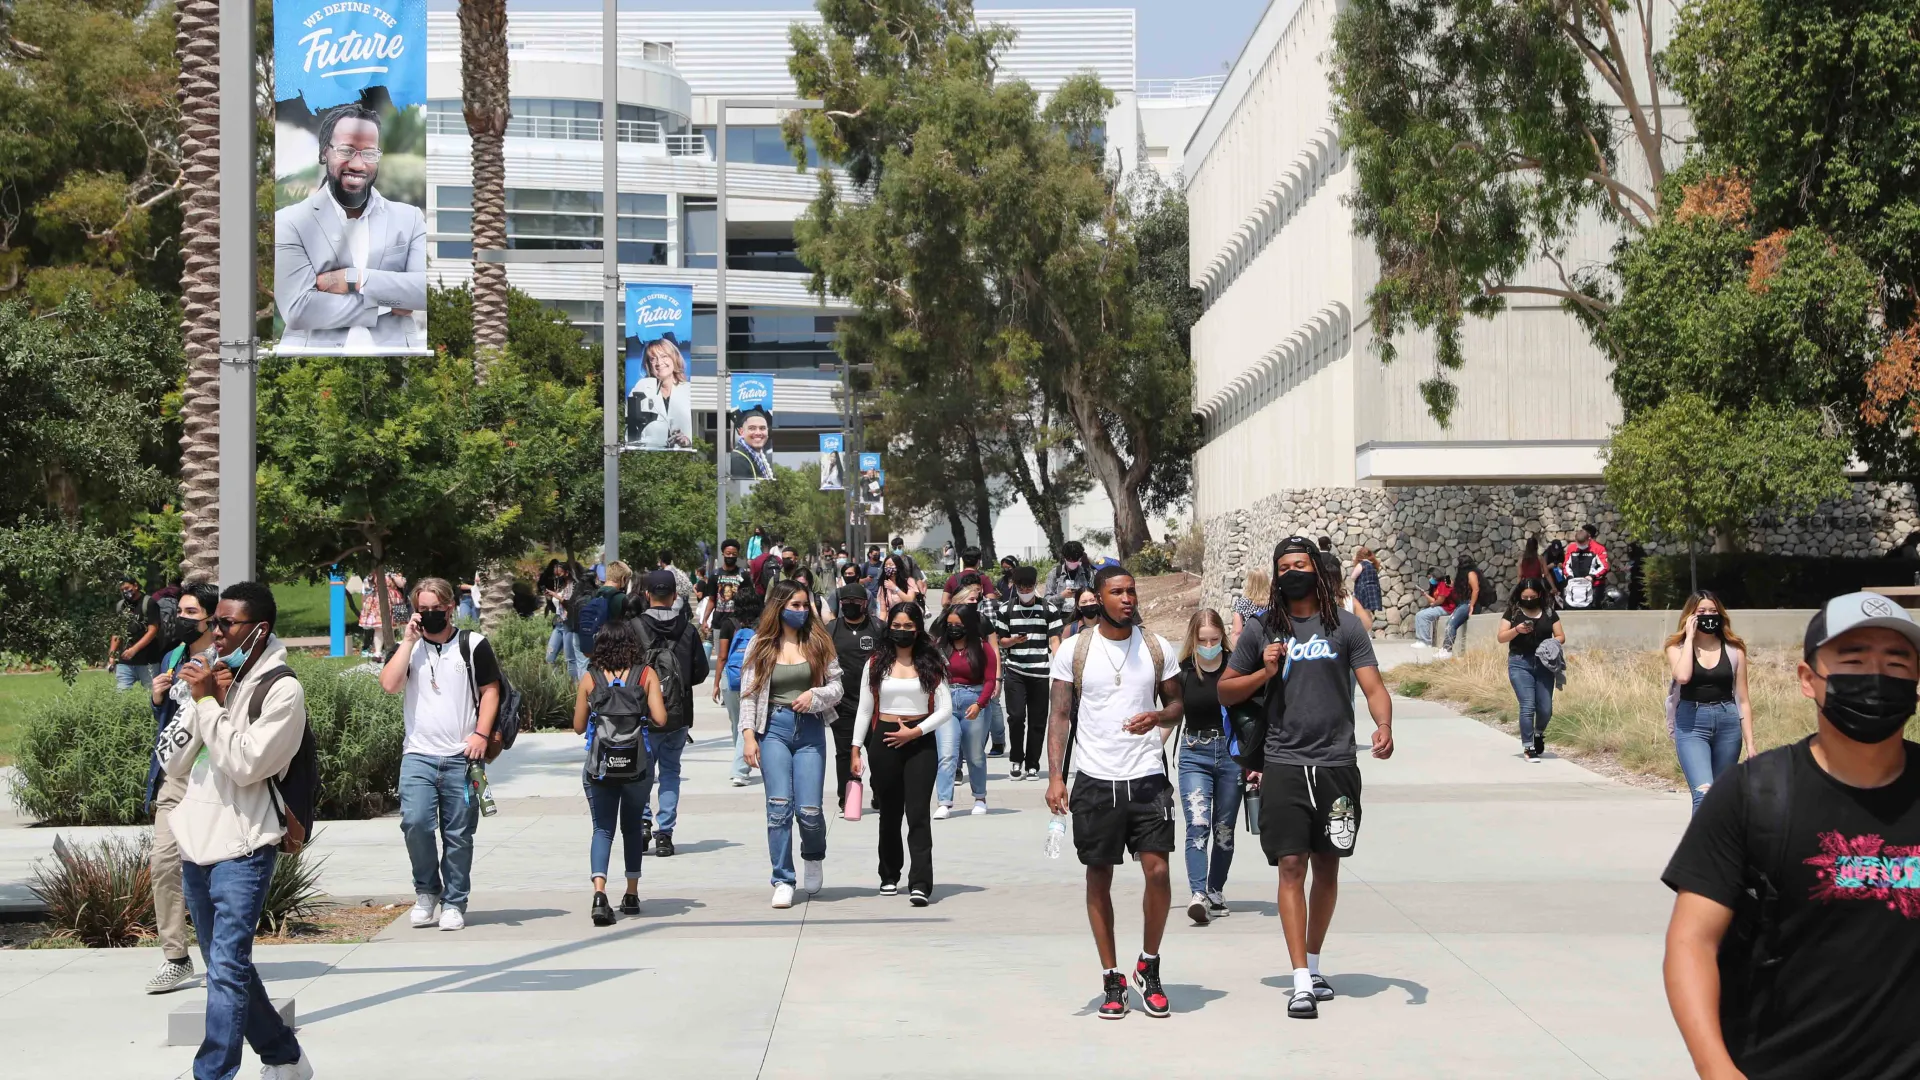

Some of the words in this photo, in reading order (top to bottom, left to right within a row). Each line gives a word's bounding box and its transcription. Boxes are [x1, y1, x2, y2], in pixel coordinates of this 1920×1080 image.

[303, 11, 324, 28] WE
[323, 1, 372, 16] DEFINE
[374, 7, 397, 28] THE
[298, 27, 405, 73] Future
[638, 297, 648, 305] WE
[668, 297, 680, 307] THE
[636, 305, 683, 325] Future
[737, 387, 767, 401] Future
